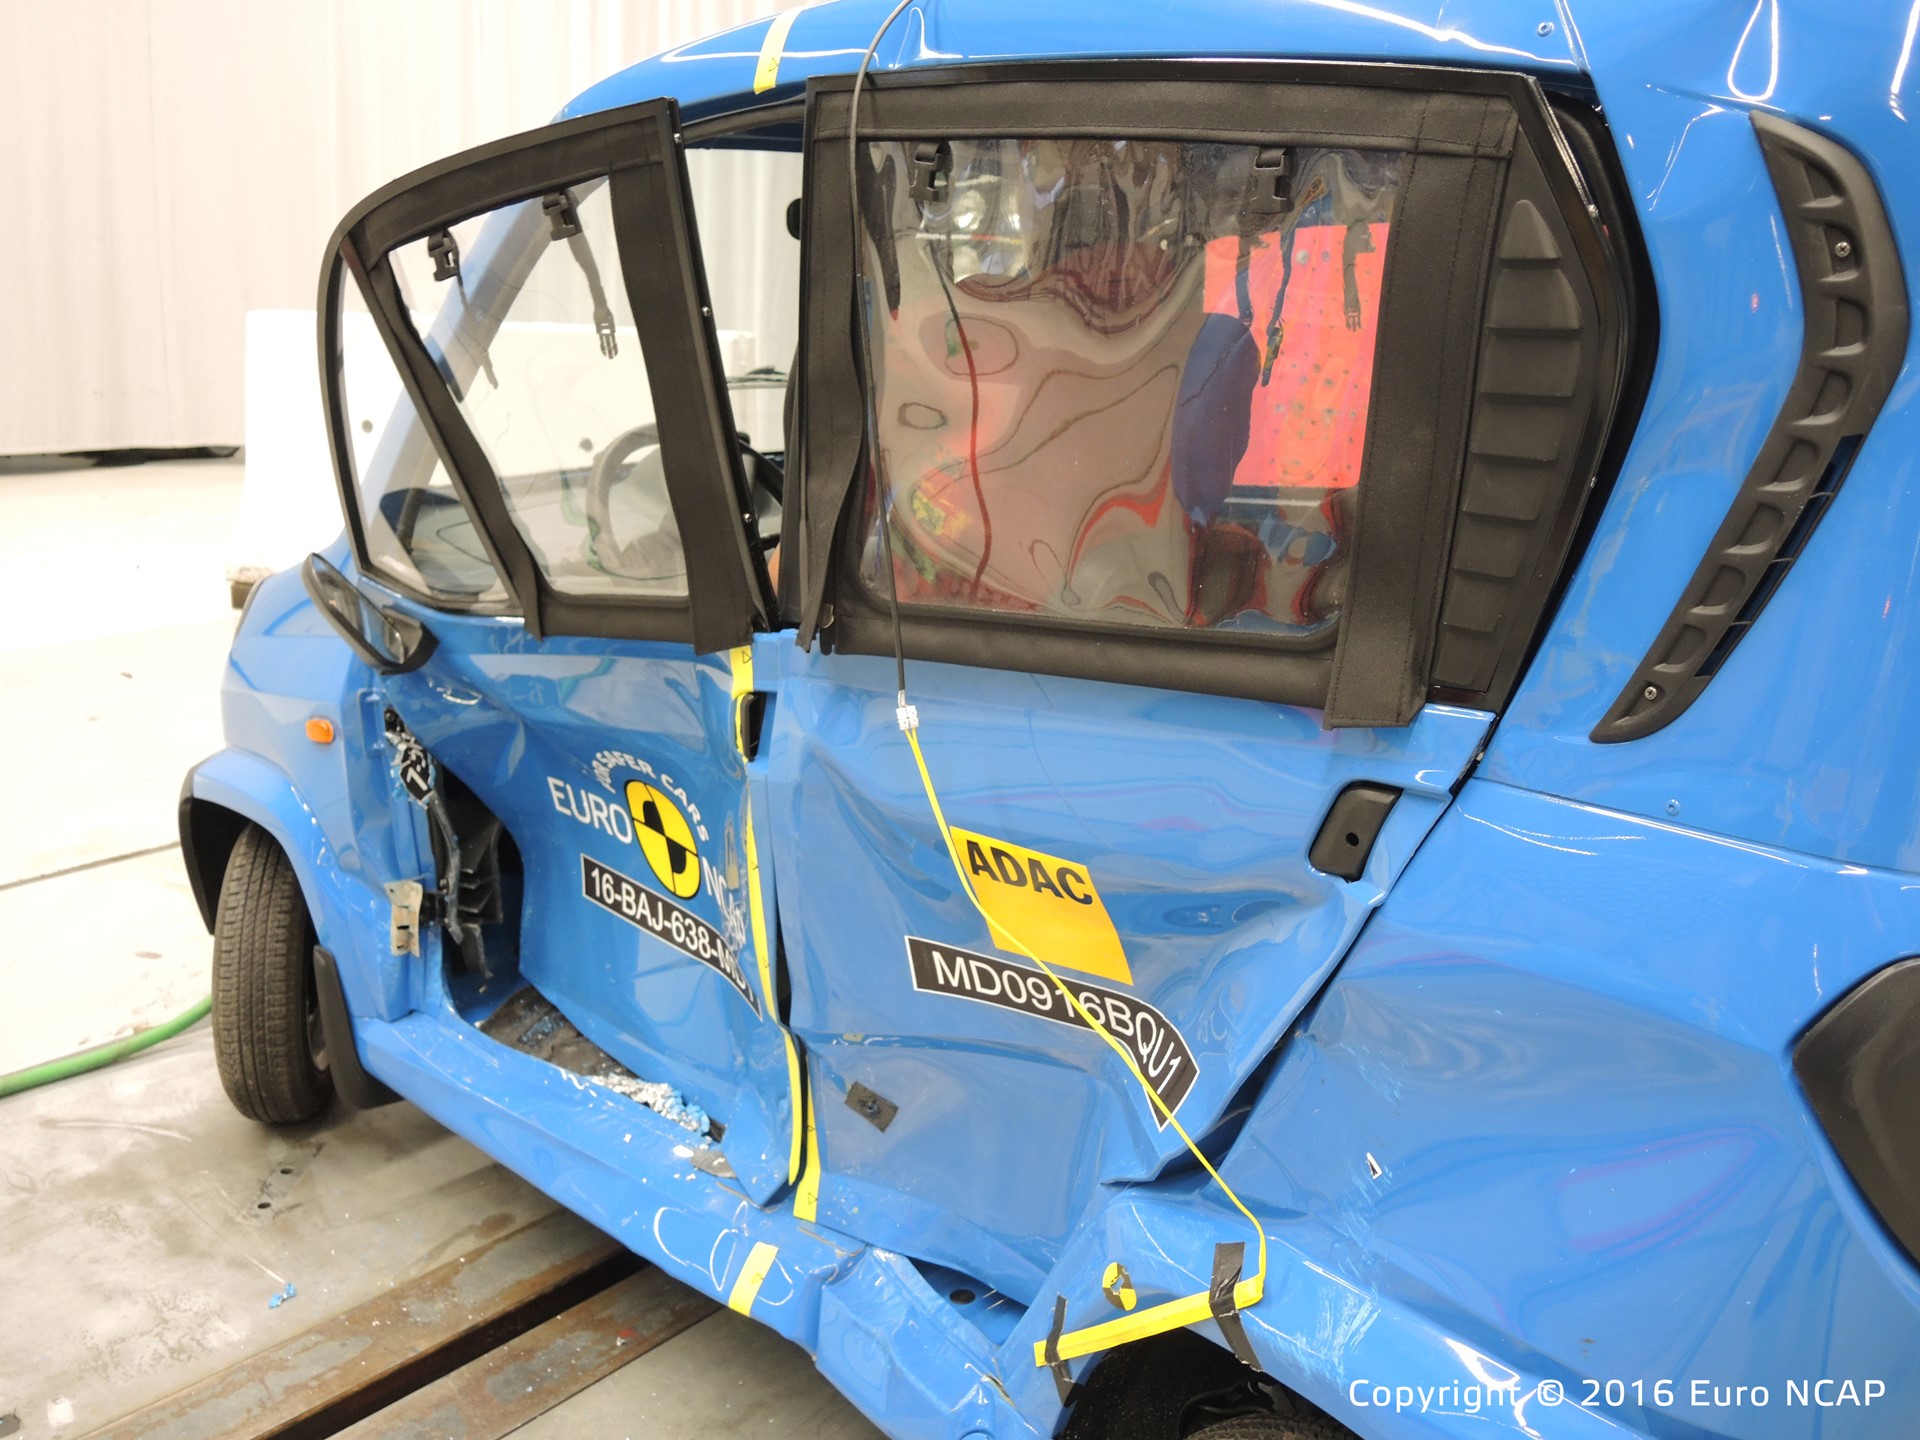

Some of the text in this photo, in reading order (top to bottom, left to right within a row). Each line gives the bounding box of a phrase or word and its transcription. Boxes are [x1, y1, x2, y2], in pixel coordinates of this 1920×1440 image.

[596, 750, 656, 779] SAFER
[661, 773, 709, 841] CARS
[547, 776, 747, 949] EURO NCAP
[966, 839, 1093, 905] ADAC
[932, 950, 1182, 1095] MD0916BQU1
